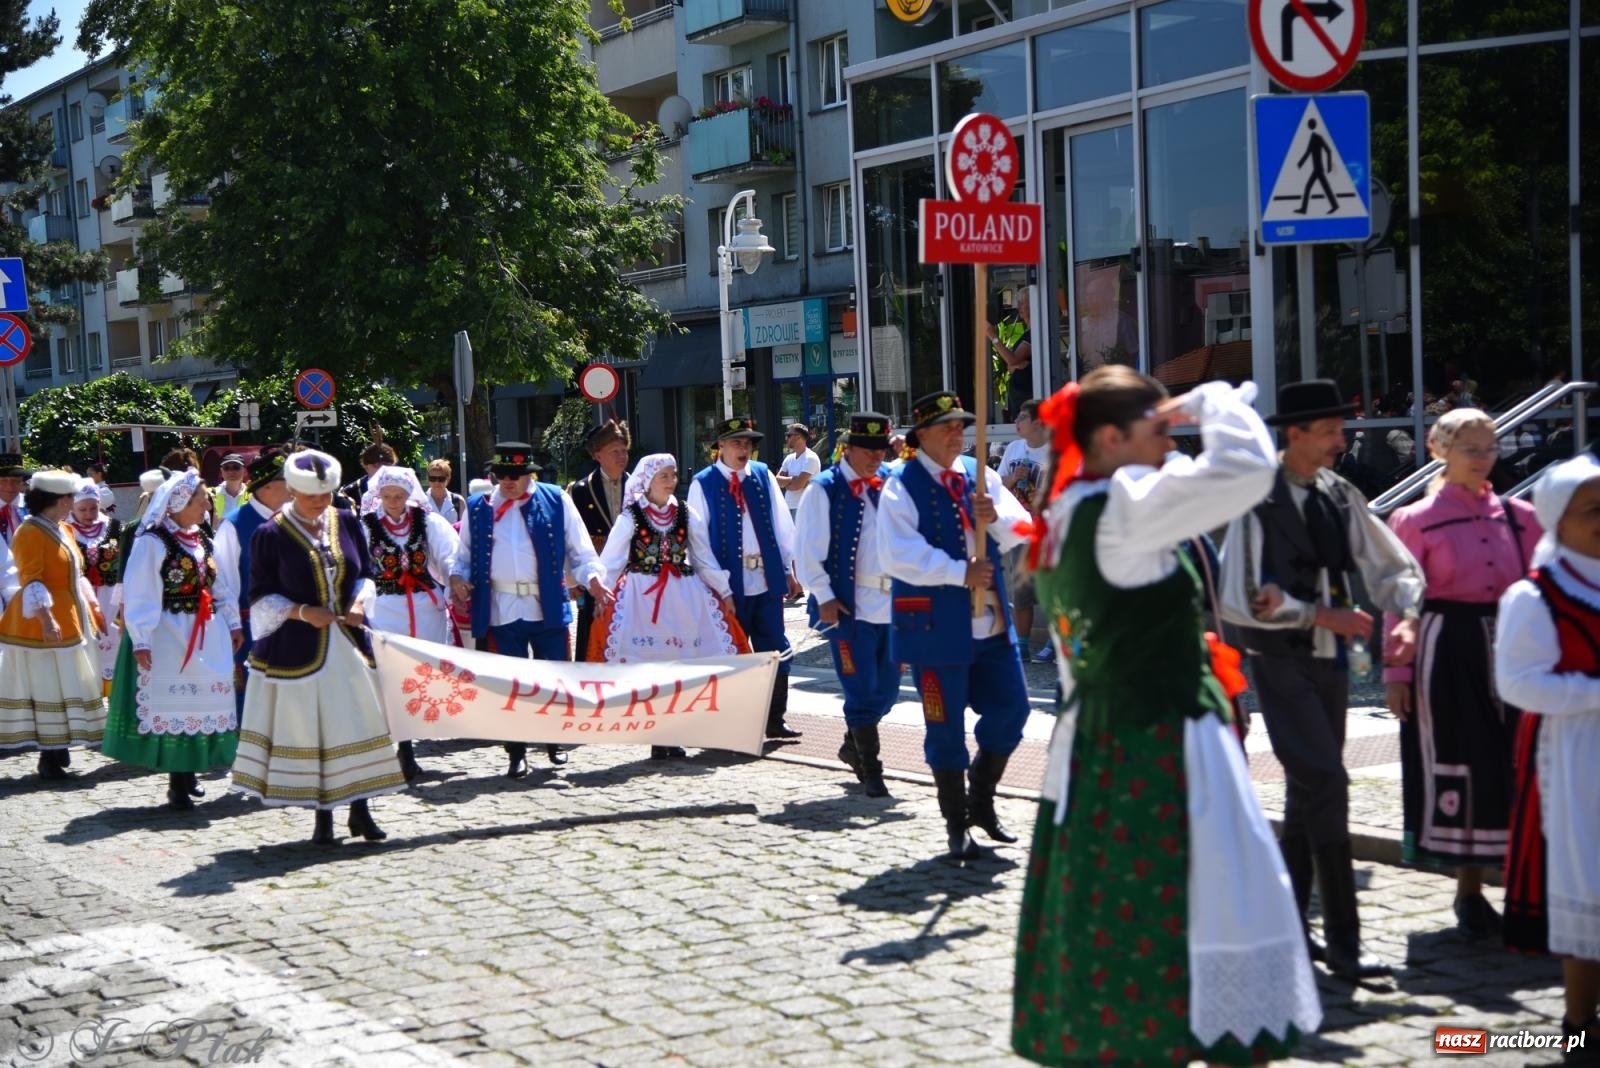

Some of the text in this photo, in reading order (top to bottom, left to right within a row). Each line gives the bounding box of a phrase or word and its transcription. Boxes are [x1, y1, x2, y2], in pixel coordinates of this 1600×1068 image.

[934, 212, 1033, 242] POLAND
[959, 242, 1003, 254] KATOWICE
[755, 322, 800, 344] ZDROWIE
[774, 352, 800, 364] DIETETYK
[501, 674, 720, 718] PATRIA
[561, 719, 656, 732] POLAND
